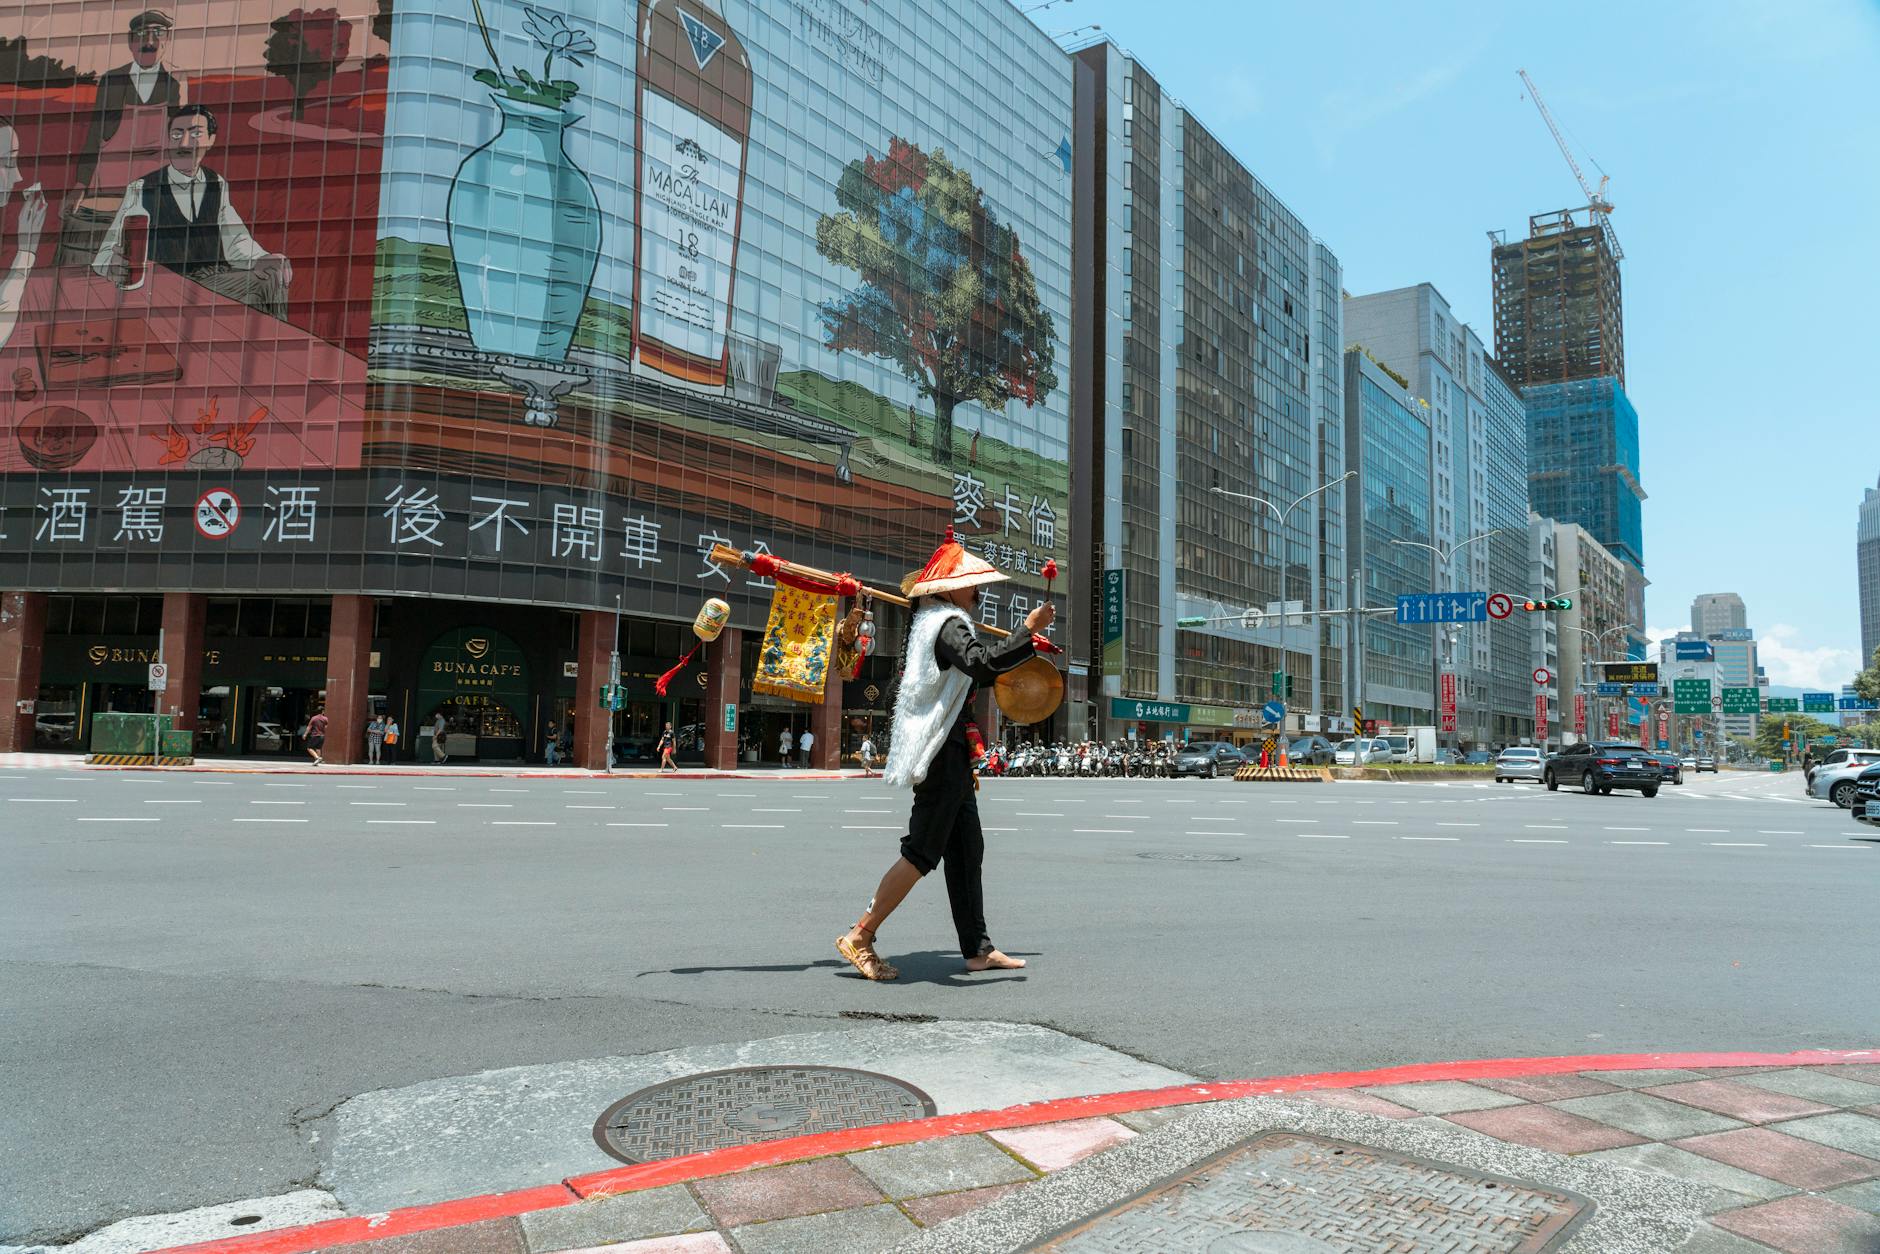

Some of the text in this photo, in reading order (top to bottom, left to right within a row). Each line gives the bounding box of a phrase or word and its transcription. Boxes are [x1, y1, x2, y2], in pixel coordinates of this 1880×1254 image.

[692, 24, 710, 49] 18
[680, 164, 699, 185] The
[649, 166, 729, 219] MACALLAN
[656, 192, 687, 210] HIGHLAND
[689, 206, 709, 221] SINGLE
[678, 228, 699, 258] 18
[0, 485, 167, 542] 酒駕
[953, 472, 1056, 549] 麥卡倫
[111, 649, 160, 662] BUNA
[433, 661, 477, 674] BUNA
[1145, 704, 1171, 718] 土地銀行
